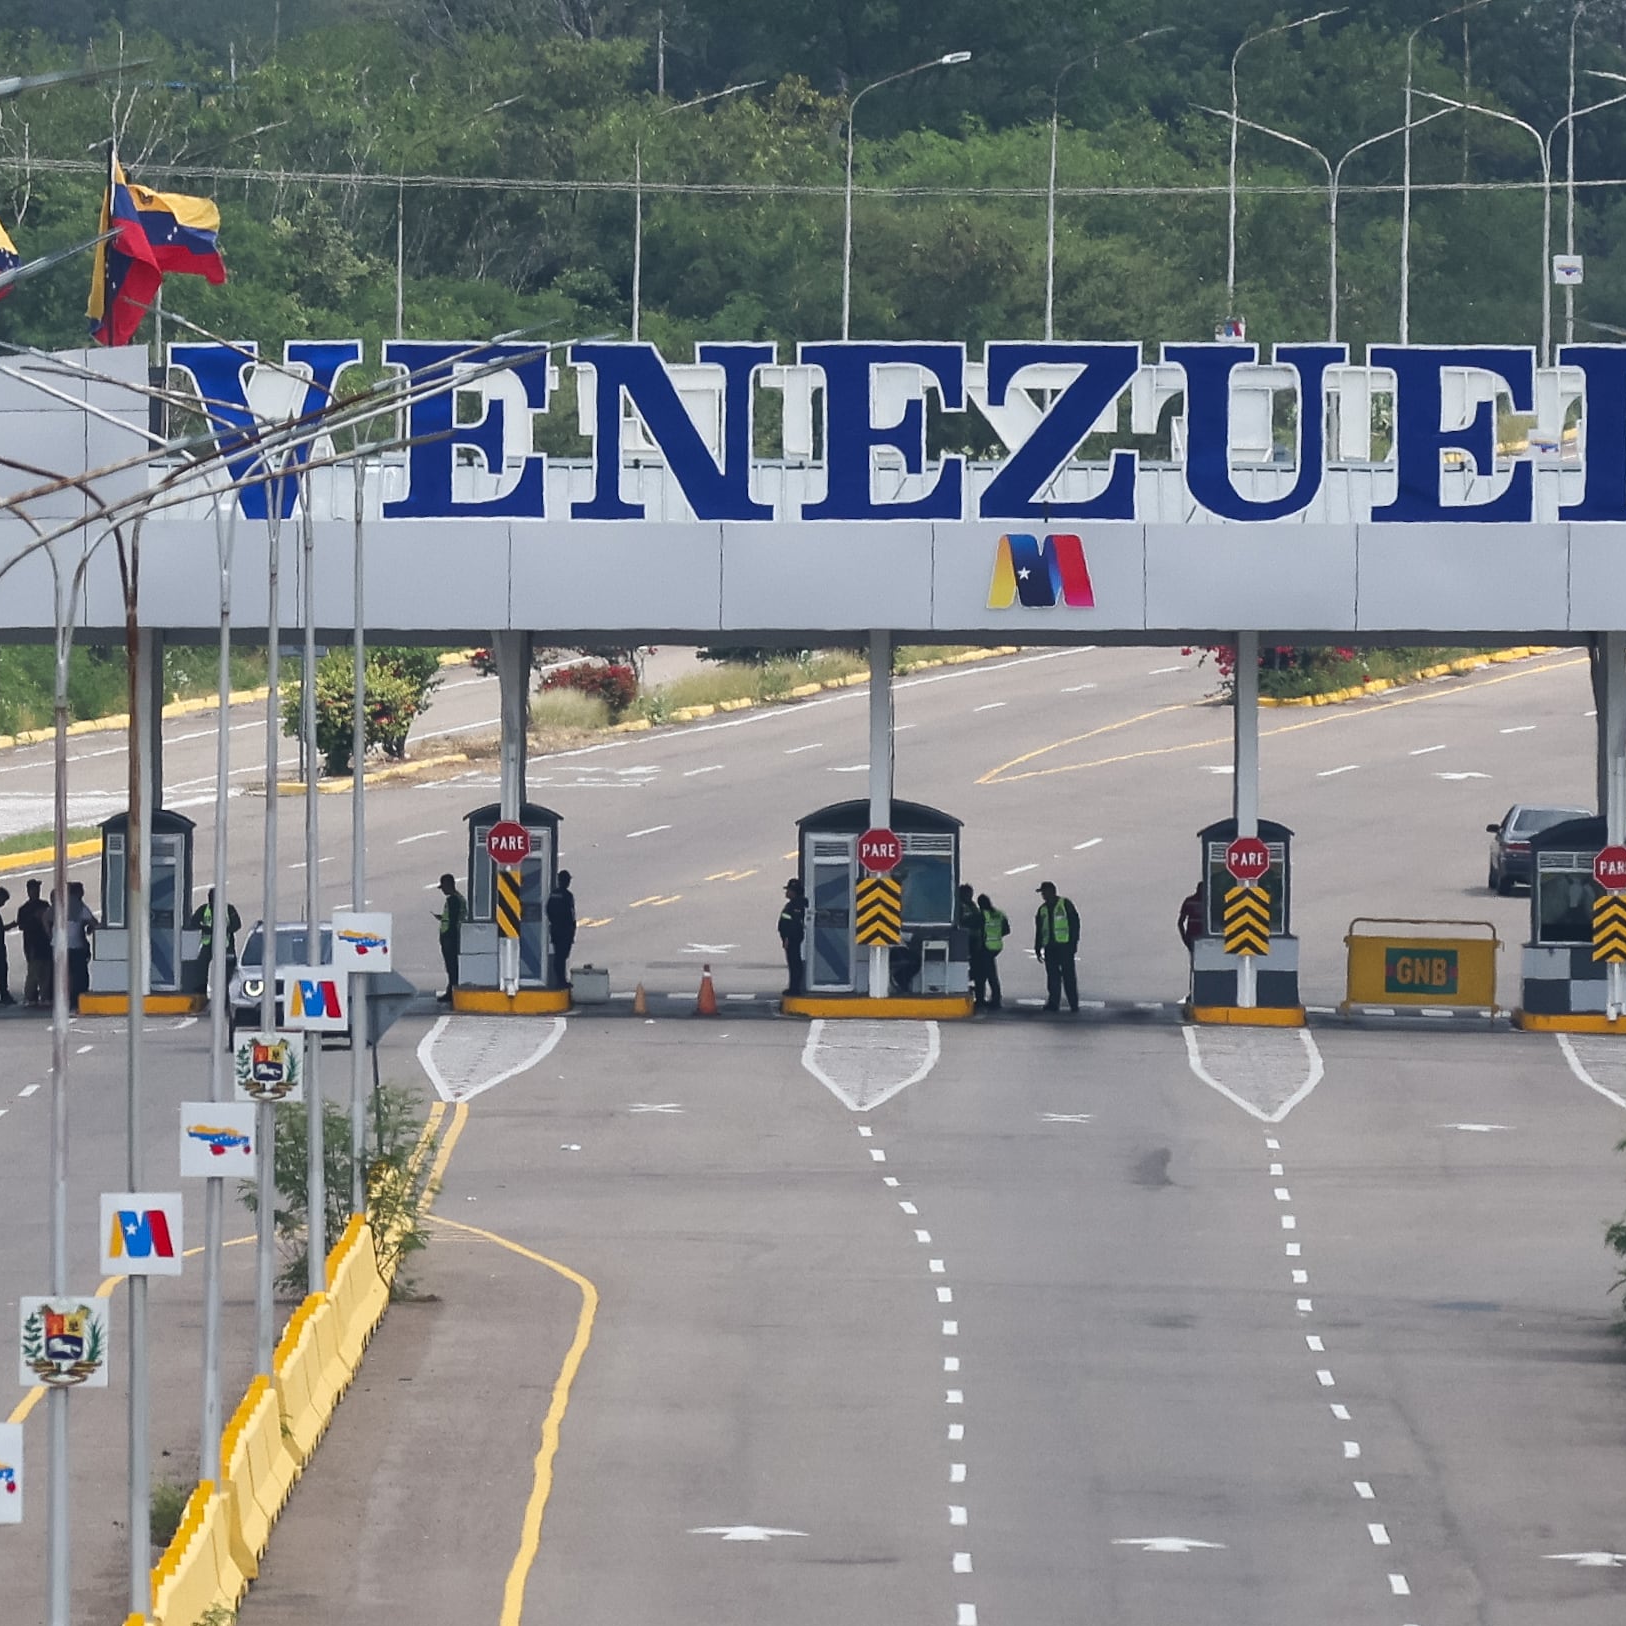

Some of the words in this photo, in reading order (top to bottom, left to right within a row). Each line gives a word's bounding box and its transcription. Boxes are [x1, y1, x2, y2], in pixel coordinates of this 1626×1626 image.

[491, 835, 524, 850] PARE
[862, 843, 895, 858] PARE
[1231, 852, 1264, 866] PARE
[1396, 956, 1448, 986] GNB
